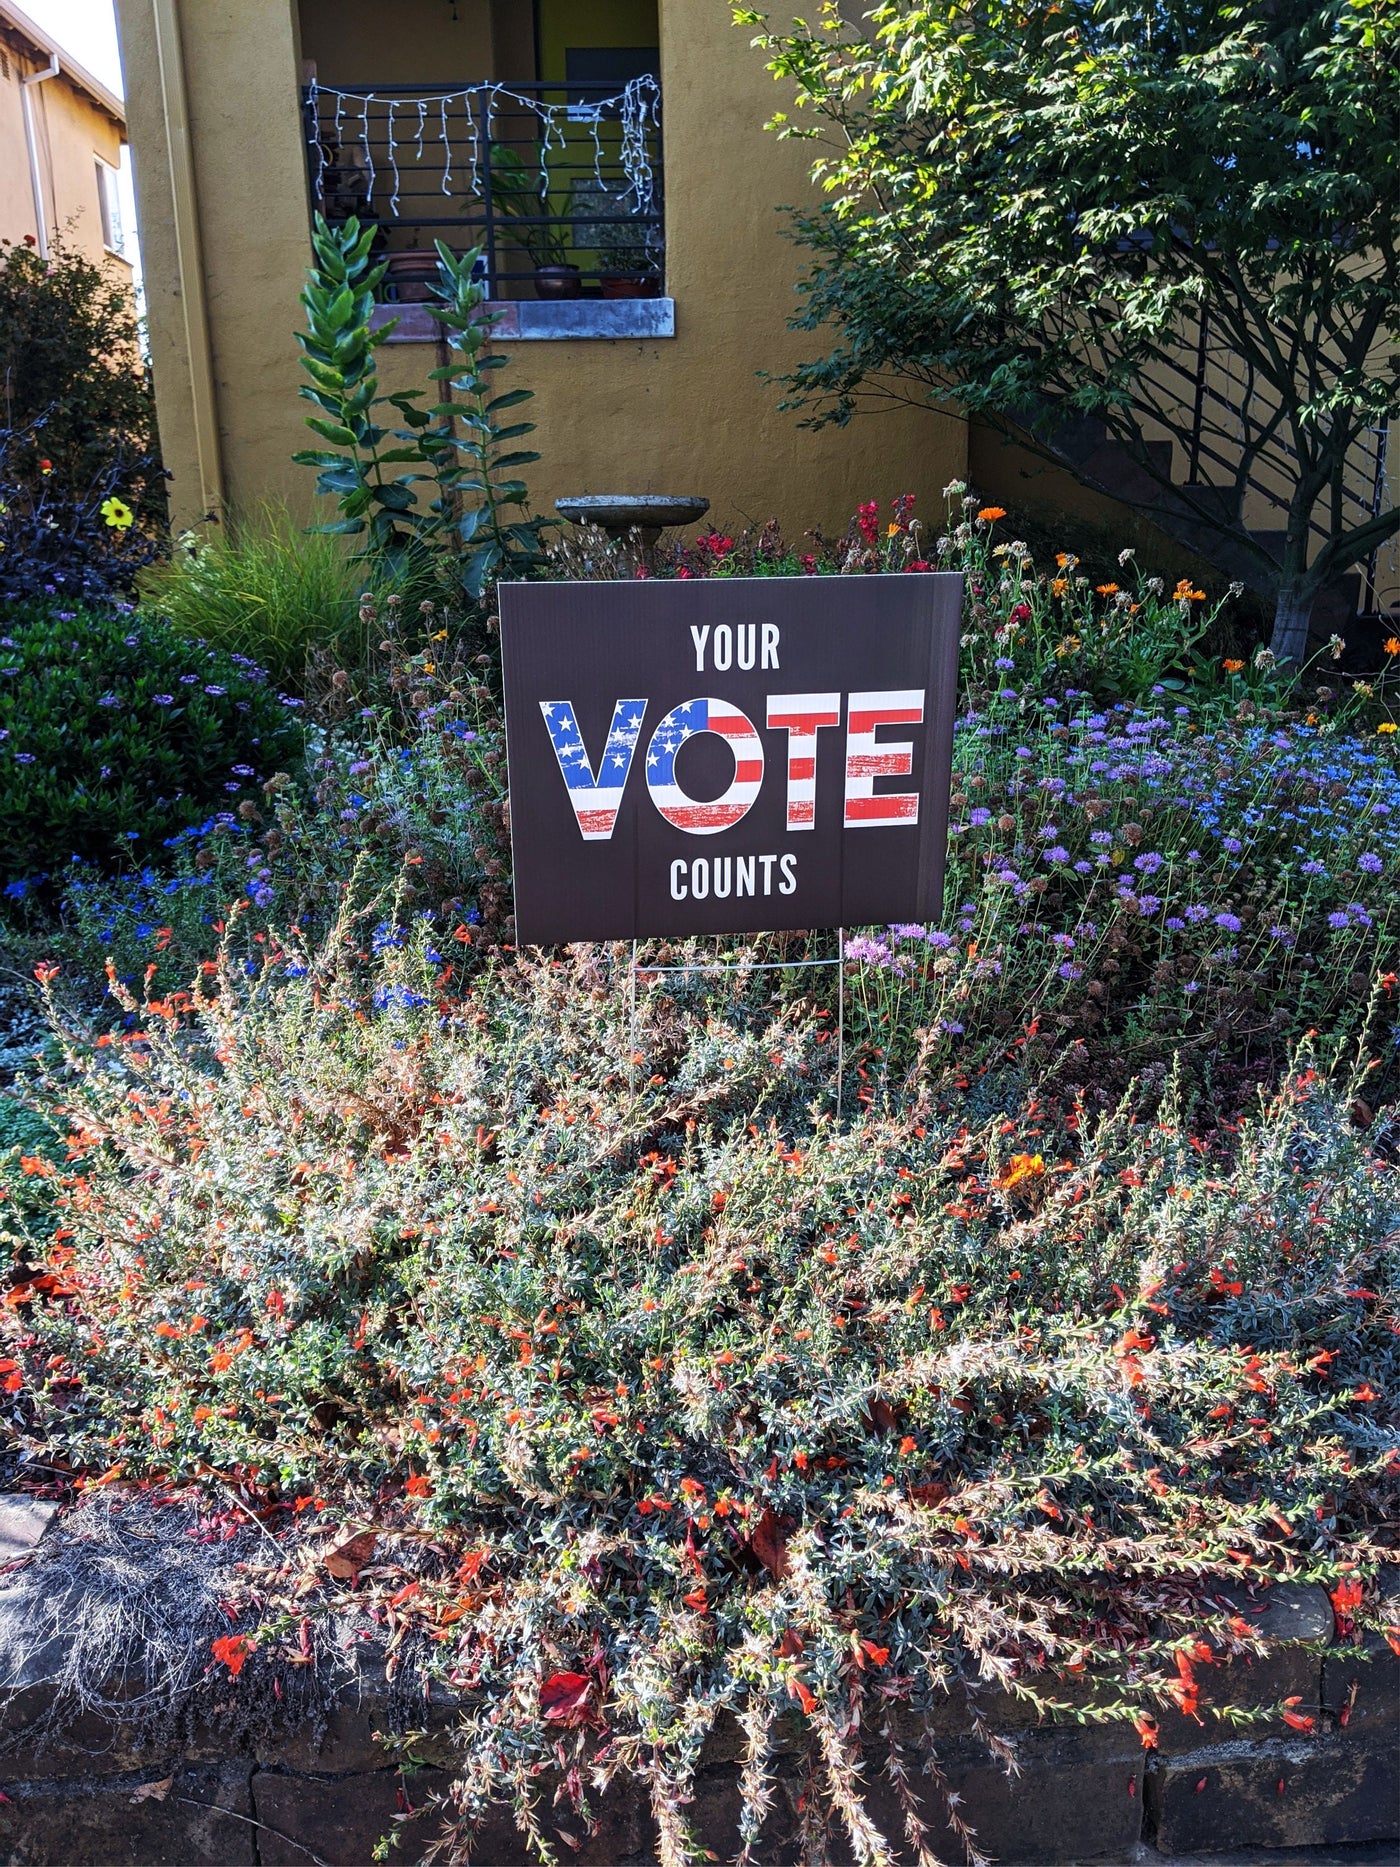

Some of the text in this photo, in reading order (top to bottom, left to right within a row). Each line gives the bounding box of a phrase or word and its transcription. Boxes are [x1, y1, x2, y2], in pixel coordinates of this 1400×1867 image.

[690, 623, 780, 672] YOUR
[538, 689, 926, 841] VOTE
[670, 854, 798, 901] COUNTS
